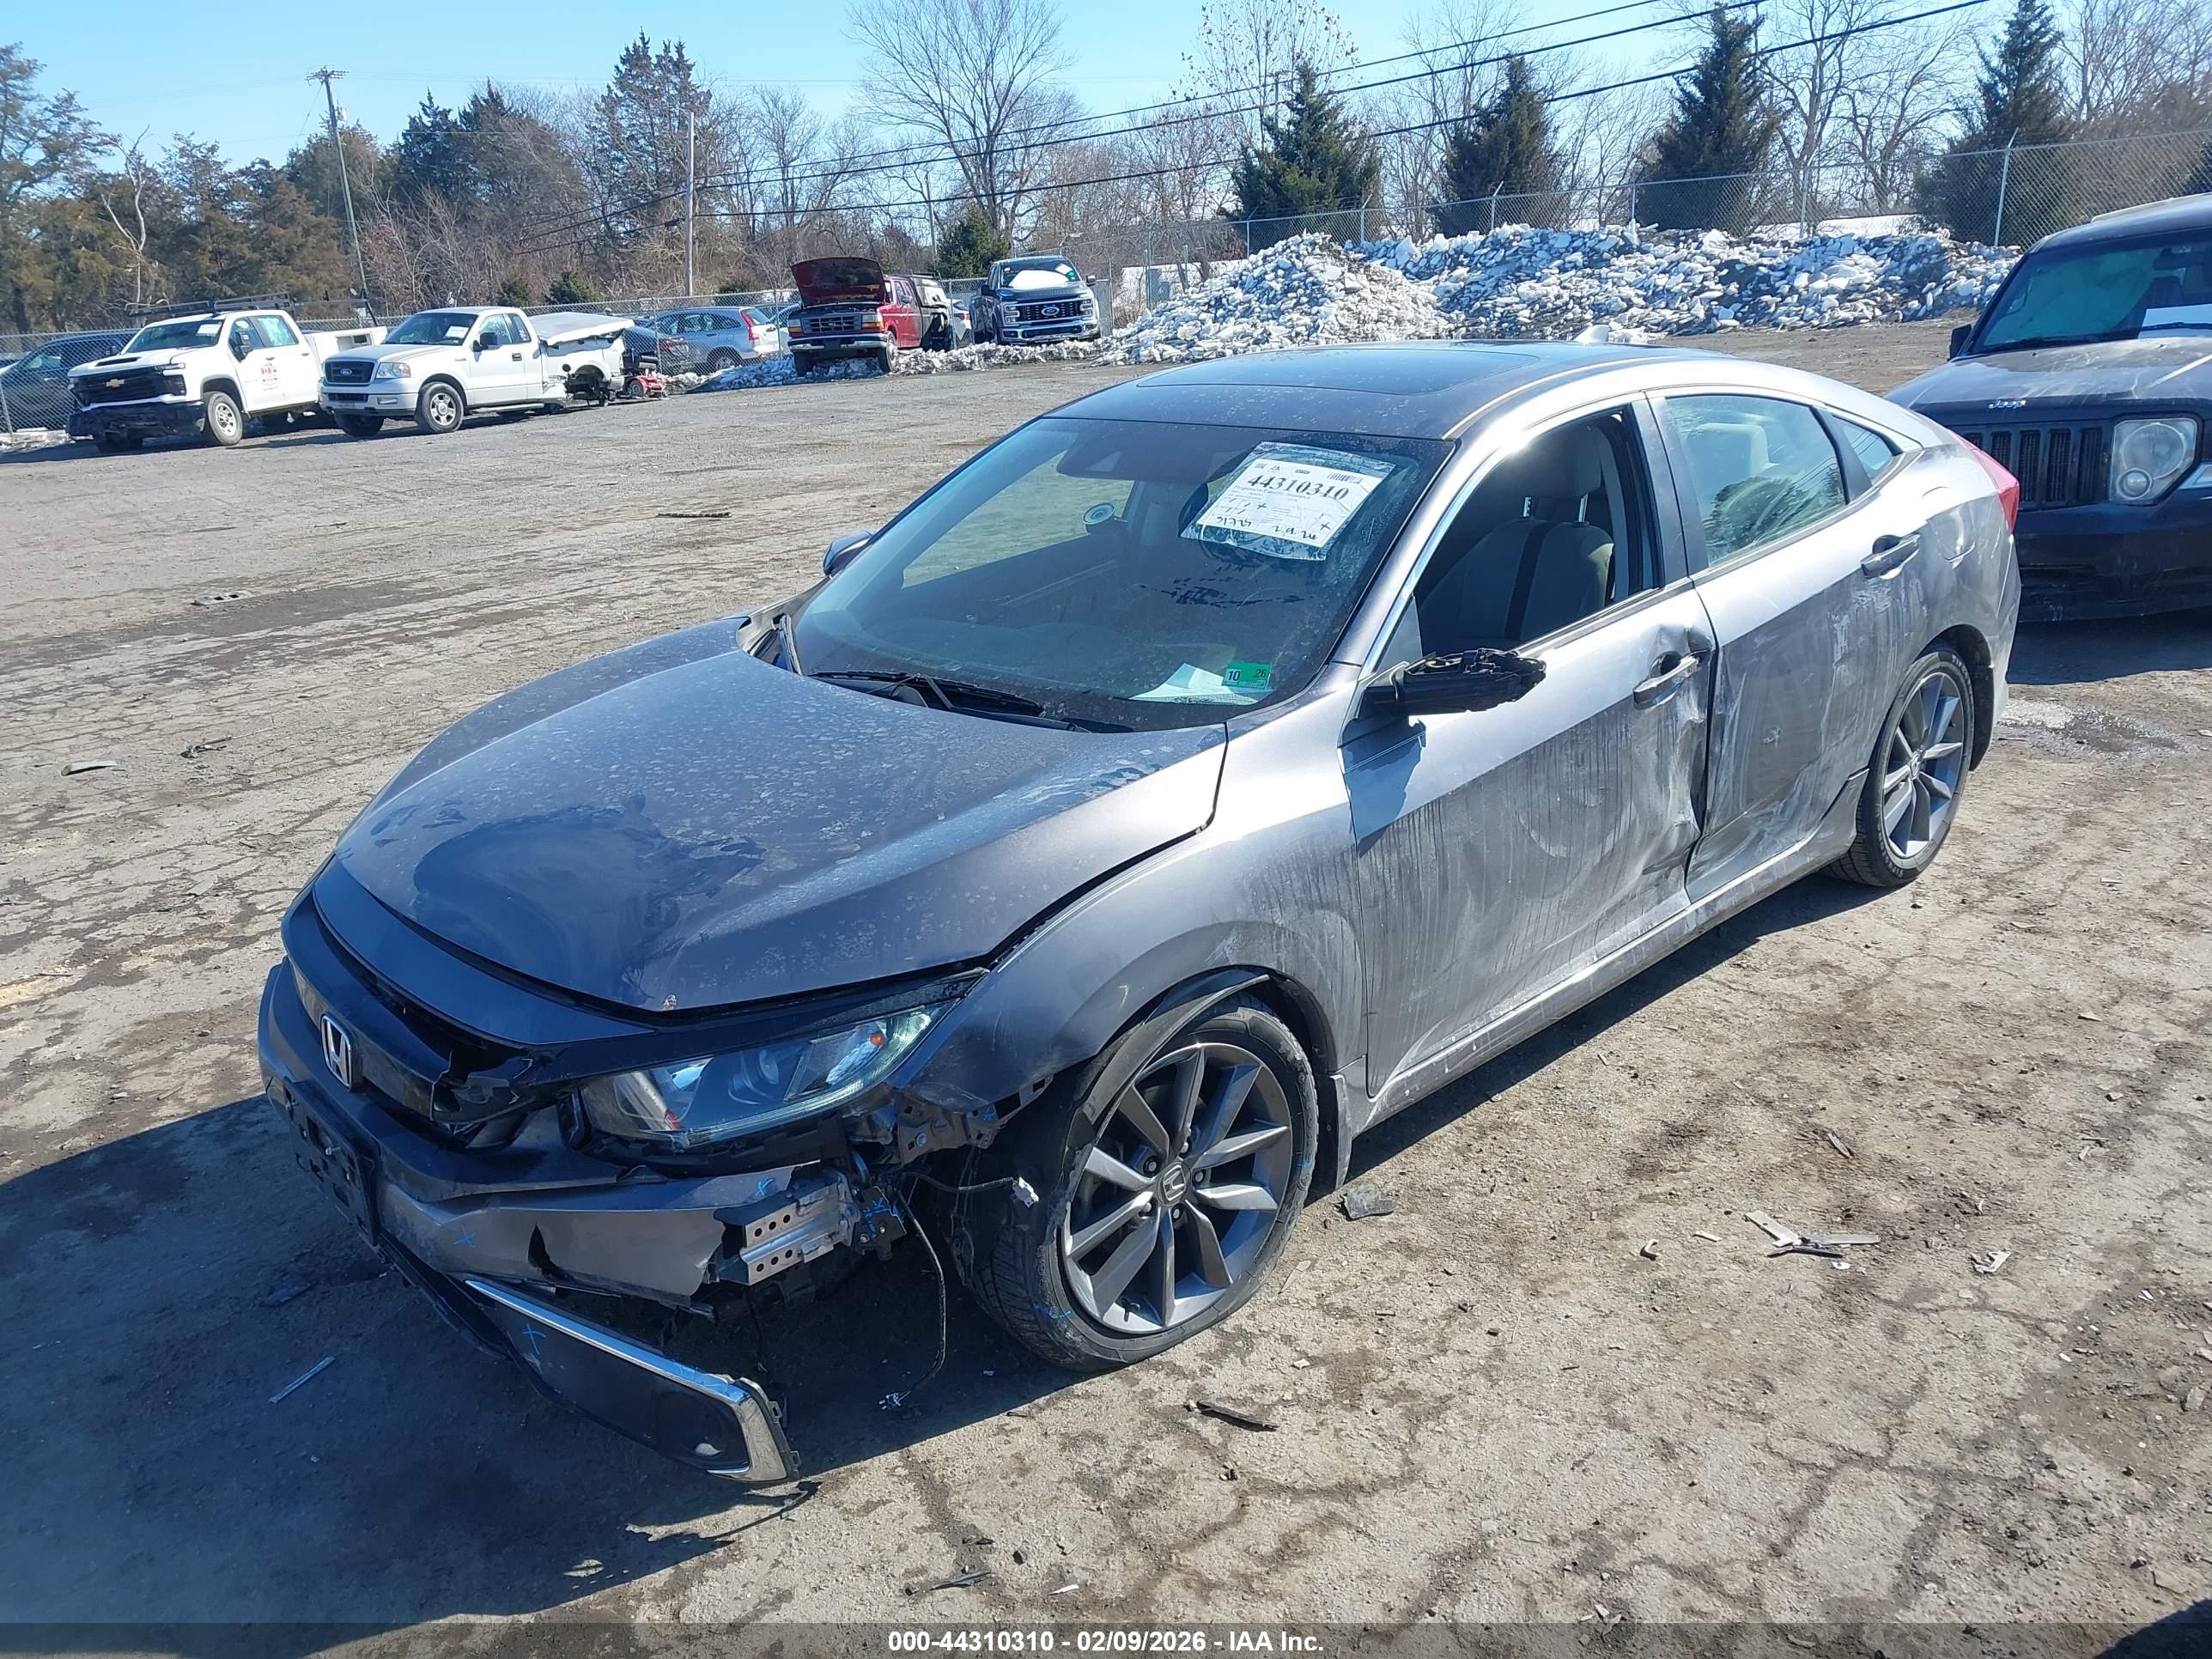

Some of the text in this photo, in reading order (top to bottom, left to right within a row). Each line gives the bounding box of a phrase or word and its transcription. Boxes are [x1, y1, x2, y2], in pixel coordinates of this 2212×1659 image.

[1988, 399, 2027, 410] Jeep
[1248, 474, 1350, 501] 44310310
[1228, 671, 1241, 681] 10
[1255, 669, 1267, 678] 26
